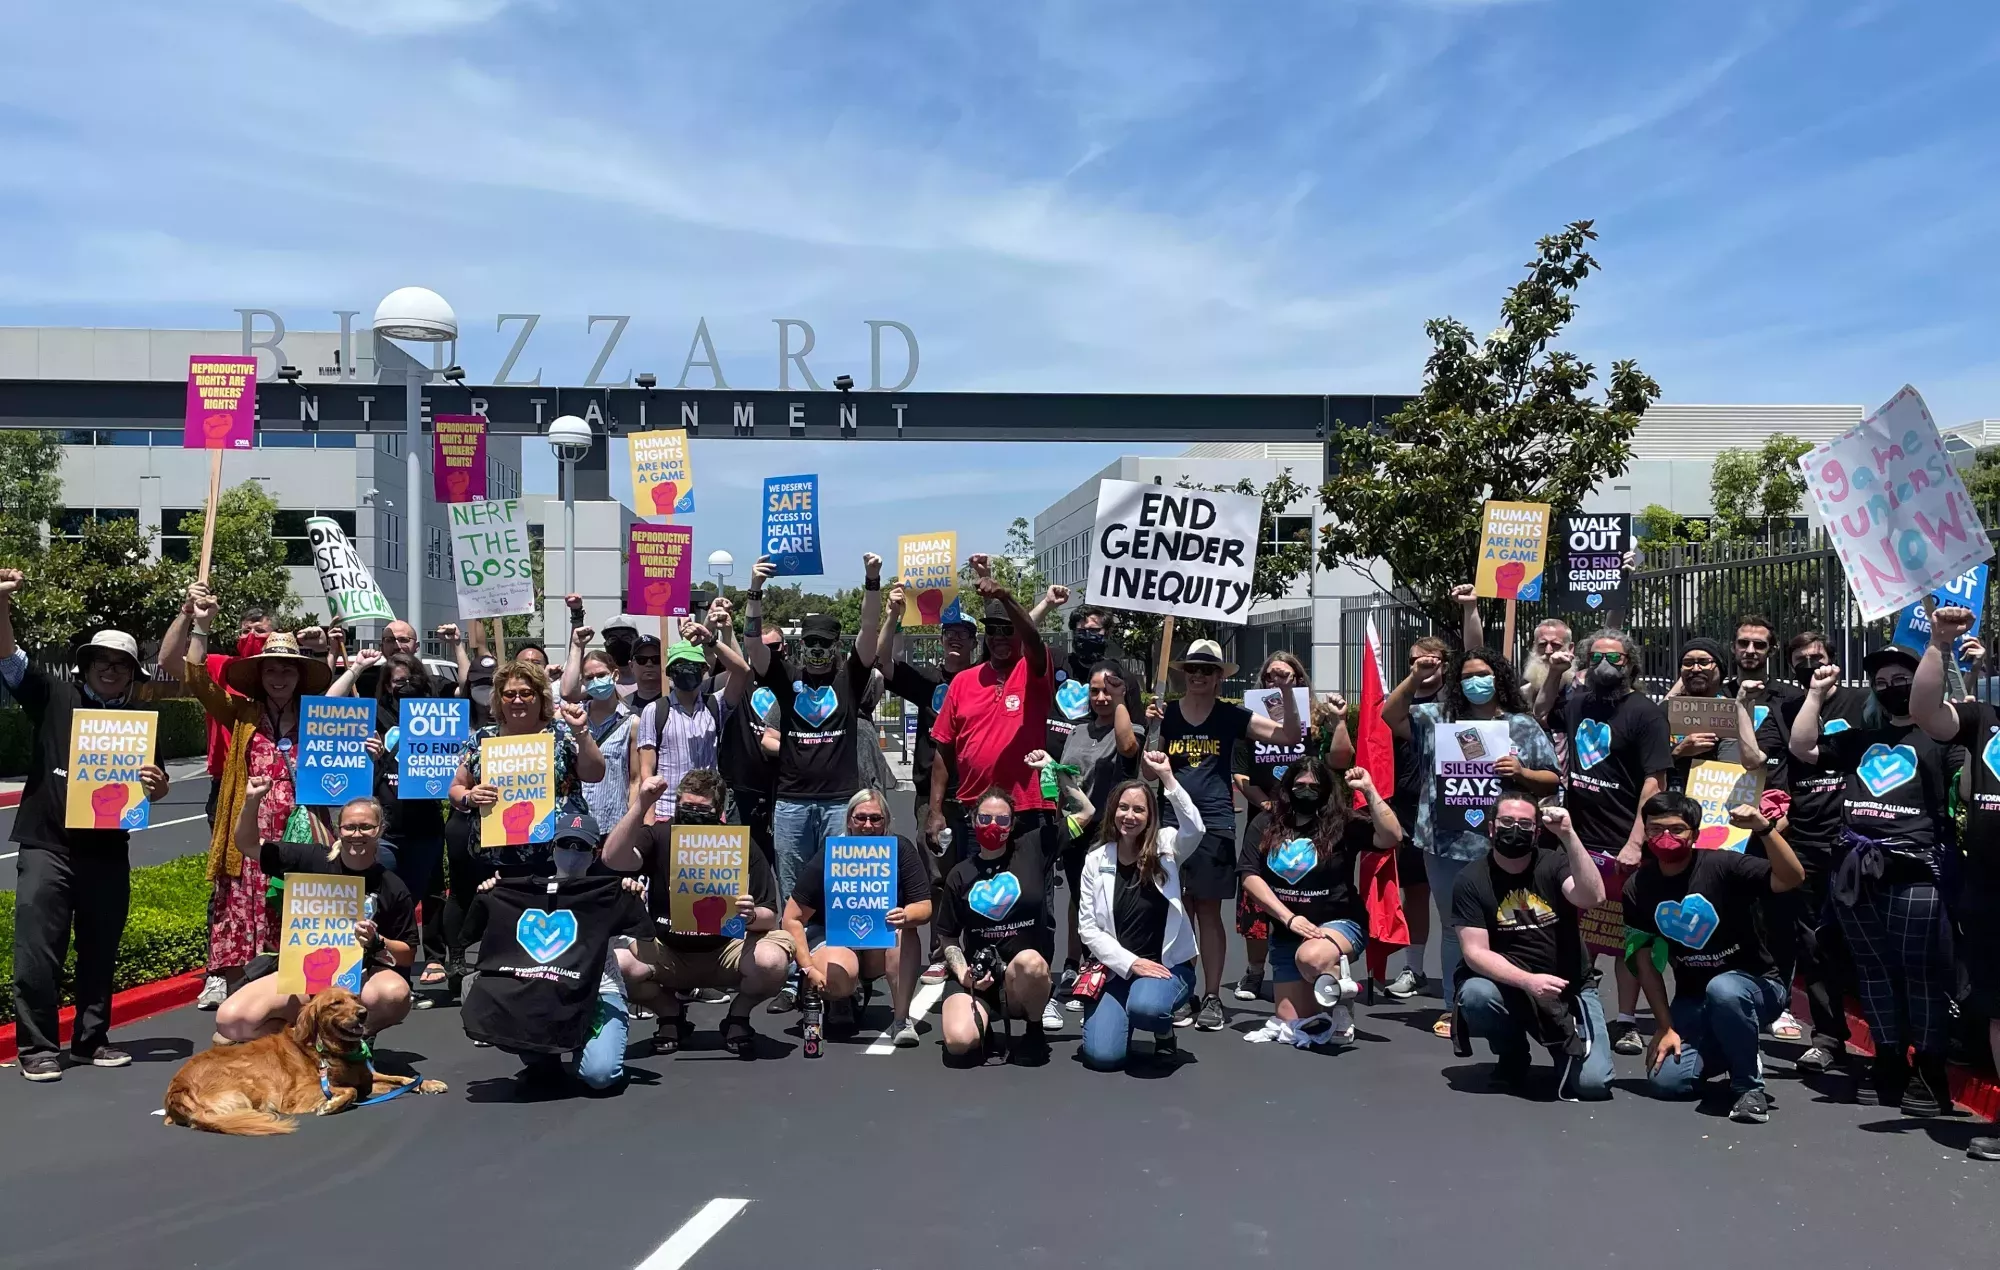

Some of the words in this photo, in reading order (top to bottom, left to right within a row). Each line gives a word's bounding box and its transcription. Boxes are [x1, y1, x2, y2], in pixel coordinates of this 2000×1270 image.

[234, 306, 921, 391] BLIZZARD
[191, 363, 255, 375] REPRODUCTIVE
[196, 375, 226, 386] RIGHTS
[229, 376, 246, 386] ARE
[200, 387, 244, 398] WORKERS'
[204, 399, 237, 410] RIGHTS!
[436, 422, 485, 434] REPRODUCTIVE
[440, 433, 462, 444] RIGHTS
[463, 434, 478, 445] ARE
[634, 435, 682, 450] HUMAN
[442, 445, 477, 456] WORKERS'
[634, 448, 684, 461] RIGHTS
[446, 456, 472, 467] RIGHTS!
[637, 461, 657, 472] ARE
[660, 460, 684, 470] NOT
[1821, 430, 1923, 503] game
[638, 474, 648, 483] A
[650, 471, 685, 481] GAME
[769, 485, 780, 493] WE
[781, 482, 812, 492] DESERVE
[768, 492, 812, 512] SAFE
[1841, 453, 1947, 539] unions
[452, 500, 518, 526] NERF
[768, 513, 799, 523] ACCESS
[800, 512, 812, 521] TO
[1139, 492, 1216, 530] END
[1490, 508, 1543, 523] HUMAN
[768, 523, 812, 537] HEALTH
[1488, 522, 1542, 537] RIGHTS
[1569, 517, 1622, 531] WALK
[457, 529, 521, 556] THE
[631, 531, 690, 544] REPRODUCTIVE
[1487, 537, 1510, 549] ARE
[1513, 539, 1540, 549] NOT
[1569, 531, 1621, 551] OUT
[636, 543, 665, 554] RIGHTS
[666, 544, 683, 555] ARE
[767, 537, 814, 554] CARE
[904, 540, 950, 553] HUMAN
[1100, 523, 1245, 567] GENDER
[1858, 491, 1968, 598] NOW
[640, 554, 681, 566] WORKERS'
[903, 551, 952, 567] RIGHTS
[1485, 549, 1495, 559] A
[1498, 550, 1538, 562] GAME
[1569, 557, 1589, 569] TO
[1592, 556, 1621, 569] END
[460, 557, 531, 586] BOSS
[644, 566, 676, 578] RIGHTS!
[904, 567, 925, 578] ARE
[927, 565, 951, 576] NOT
[1568, 569, 1621, 581] GENDER
[904, 579, 912, 589] A
[915, 577, 952, 589] GAME
[1569, 581, 1620, 592] INEQUITY
[1945, 575, 1978, 600] UT
[1100, 565, 1250, 615] INEQUITY
[308, 705, 369, 720] HUMAN
[409, 702, 461, 716] WALK
[80, 719, 148, 734] HUMAN
[409, 716, 460, 736] OUT
[1683, 716, 1701, 725] ON
[307, 721, 368, 737] RIGHTS
[78, 736, 147, 752] RIGHTS
[306, 740, 333, 752] ARE
[337, 741, 366, 752] NOT
[408, 743, 428, 754] TO
[432, 743, 460, 754] END
[488, 742, 547, 758] HUMAN
[1168, 740, 1184, 755] UC
[1186, 739, 1220, 756] IRVINE
[77, 754, 107, 766] ARE
[112, 755, 146, 766] NOT
[305, 754, 318, 767] A
[320, 755, 366, 768] GAME
[407, 754, 460, 766] GENDER
[487, 757, 548, 775] RIGHTS
[76, 768, 90, 781] A
[408, 767, 459, 778] INEQUITY
[1444, 763, 1495, 775] SILENC
[518, 773, 547, 785] NOT
[1696, 768, 1758, 787] HUMAN
[1444, 778, 1503, 796] SAYS
[1692, 782, 1755, 802] RIGHTS
[503, 787, 546, 802] GAME
[1445, 797, 1497, 805] EVERYTHIN
[1702, 800, 1718, 811] RE
[1883, 804, 1920, 815] ALLIANCE
[1879, 811, 1896, 819] ABK
[679, 834, 742, 849] HUMAN
[677, 851, 743, 866] RIGHTS
[831, 845, 891, 859] HUMAN
[677, 868, 705, 880] ARE
[710, 868, 741, 880] NOT
[831, 862, 891, 877] RIGHTS
[292, 883, 358, 899] HUMAN
[677, 882, 689, 894] A
[693, 882, 740, 896] GAME
[831, 881, 858, 893] ARE
[860, 881, 890, 893] NOT
[1300, 889, 1330, 897] ALLIANCE
[290, 899, 358, 915] RIGHTS
[831, 896, 843, 909] A
[846, 896, 890, 909] GAME
[289, 918, 320, 930] ARE
[325, 918, 358, 930] NOT
[1007, 919, 1035, 930] ALLIANCE
[288, 932, 302, 946] A
[306, 932, 356, 946] GAME
[544, 972, 559, 982] ABK
[547, 966, 581, 979] ALLIANCE
